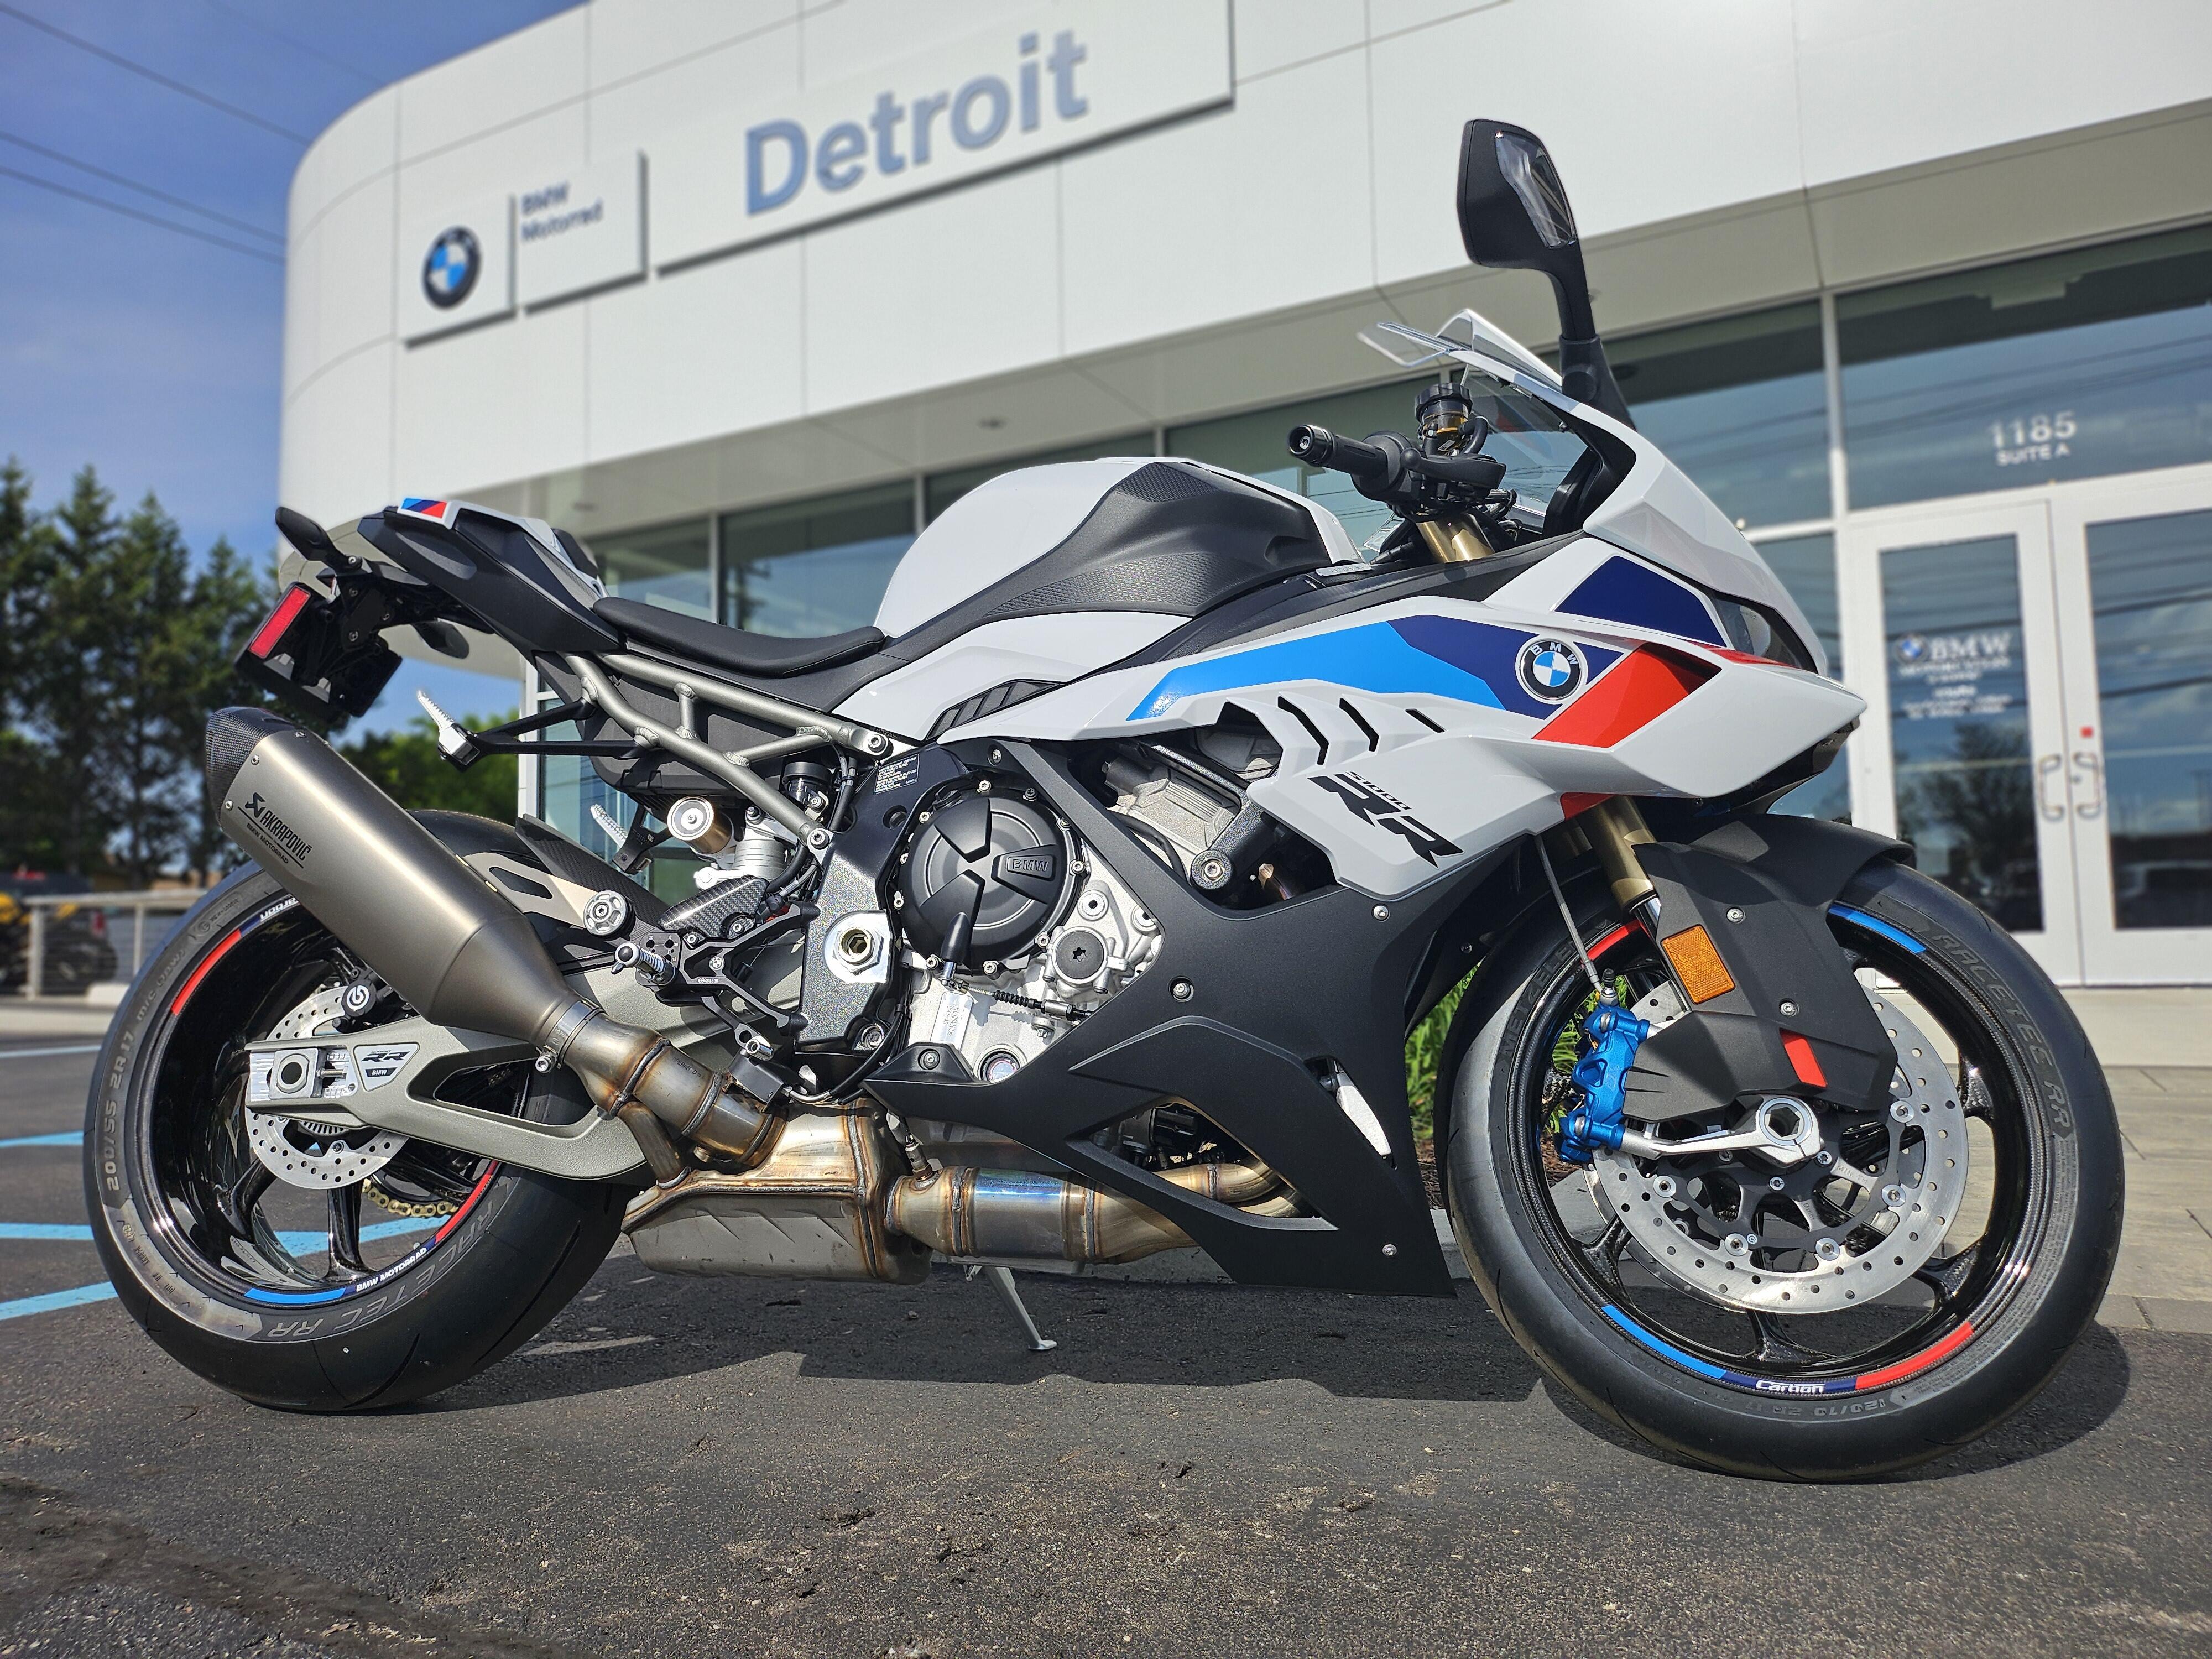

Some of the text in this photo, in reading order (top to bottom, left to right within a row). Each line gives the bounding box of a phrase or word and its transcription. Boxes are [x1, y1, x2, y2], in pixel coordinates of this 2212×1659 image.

[745, 30, 1088, 217] Detroit
[522, 181, 570, 215] BMW
[1990, 409, 2078, 448] 1185
[1996, 442, 2071, 466] SUITE A
[1530, 642, 1578, 665] BMW
[1929, 632, 2011, 659] BMW
[1345, 771, 1412, 810] S1000
[1306, 773, 1464, 869] RR
[247, 822, 259, 837] BMW
[260, 834, 289, 864] MOTORRAD
[1013, 859, 1048, 872] BMW
[260, 896, 299, 922] arbon
[1837, 1165, 1853, 1177] MIN
[356, 1247, 427, 1292] BMW MOTORRAD
[1756, 1380, 1825, 1393] Carbon
